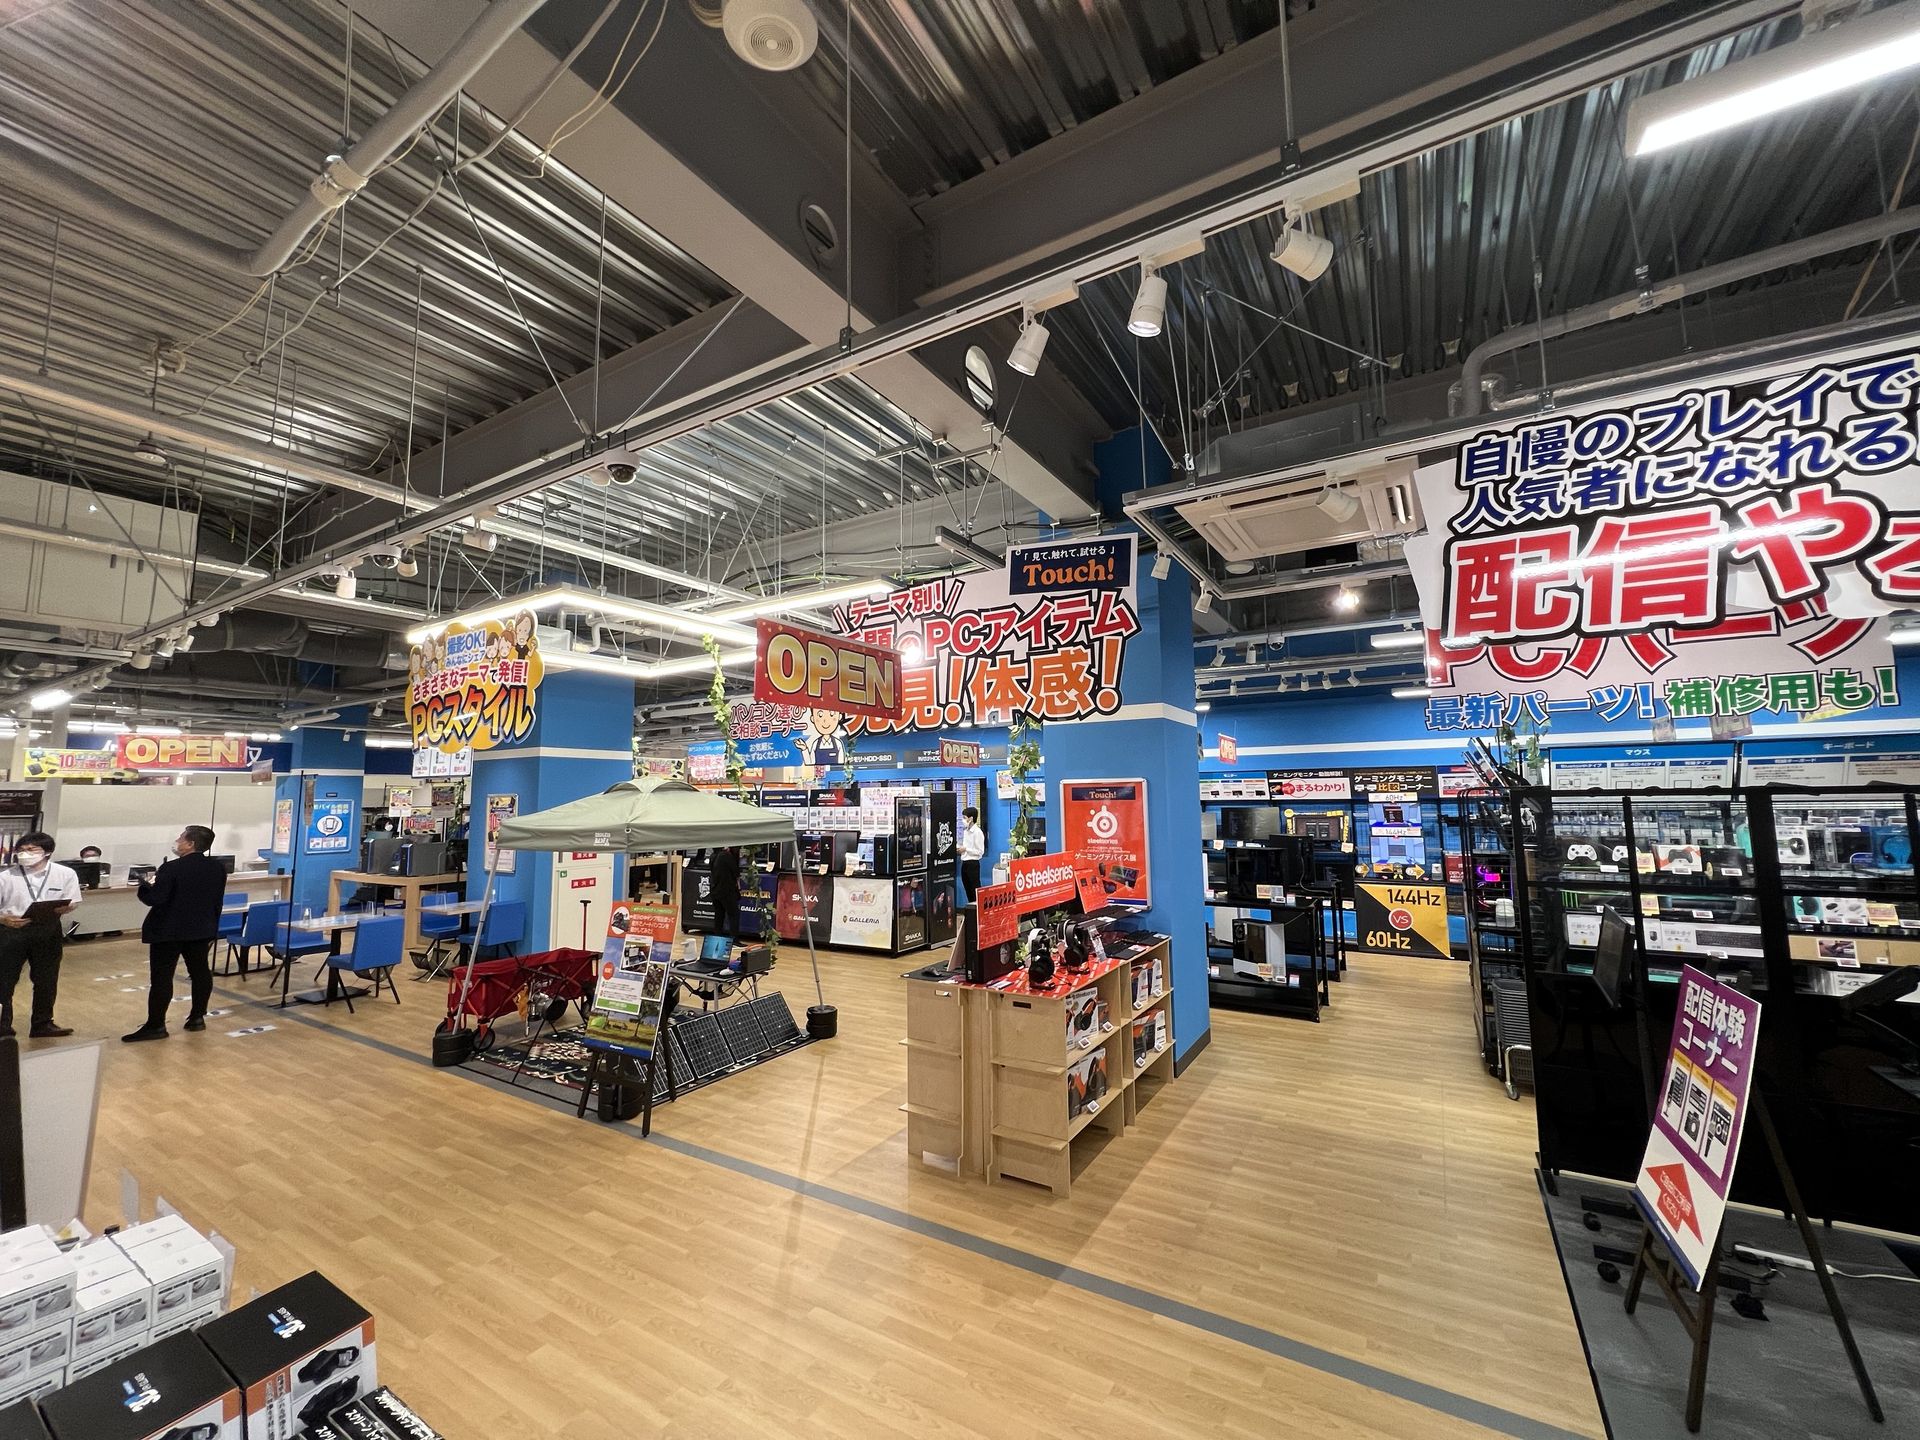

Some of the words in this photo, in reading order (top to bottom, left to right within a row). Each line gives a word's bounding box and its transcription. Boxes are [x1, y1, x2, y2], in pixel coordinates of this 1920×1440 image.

[1463, 356, 1920, 483] 自慢のプレイで
[1023, 557, 1114, 587] Touch!
[848, 590, 1140, 660] 題のPCアイテム
[412, 660, 530, 703] さまざまなテーマで発信!
[766, 632, 895, 710] OPEN
[1426, 682, 1656, 731] 最新パーツ!
[1664, 665, 1901, 719] 補修用も!
[411, 684, 534, 753] PCスタイル
[125, 738, 239, 764] OPEN
[943, 743, 979, 765] OPEN
[1624, 748, 1651, 756] マウス
[1822, 740, 1876, 750] キーボード
[1295, 783, 1346, 793] まるわかり!
[1353, 774, 1433, 784] ゲーミングモニター
[1089, 791, 1117, 799] Touch!
[1025, 862, 1074, 890] steelseries
[1386, 888, 1442, 907] 144Hz
[1391, 914, 1410, 925] VS
[1365, 929, 1412, 950] 60Hz
[1682, 978, 1747, 1049] 配信体験
[1678, 1017, 1739, 1075] コーナー
